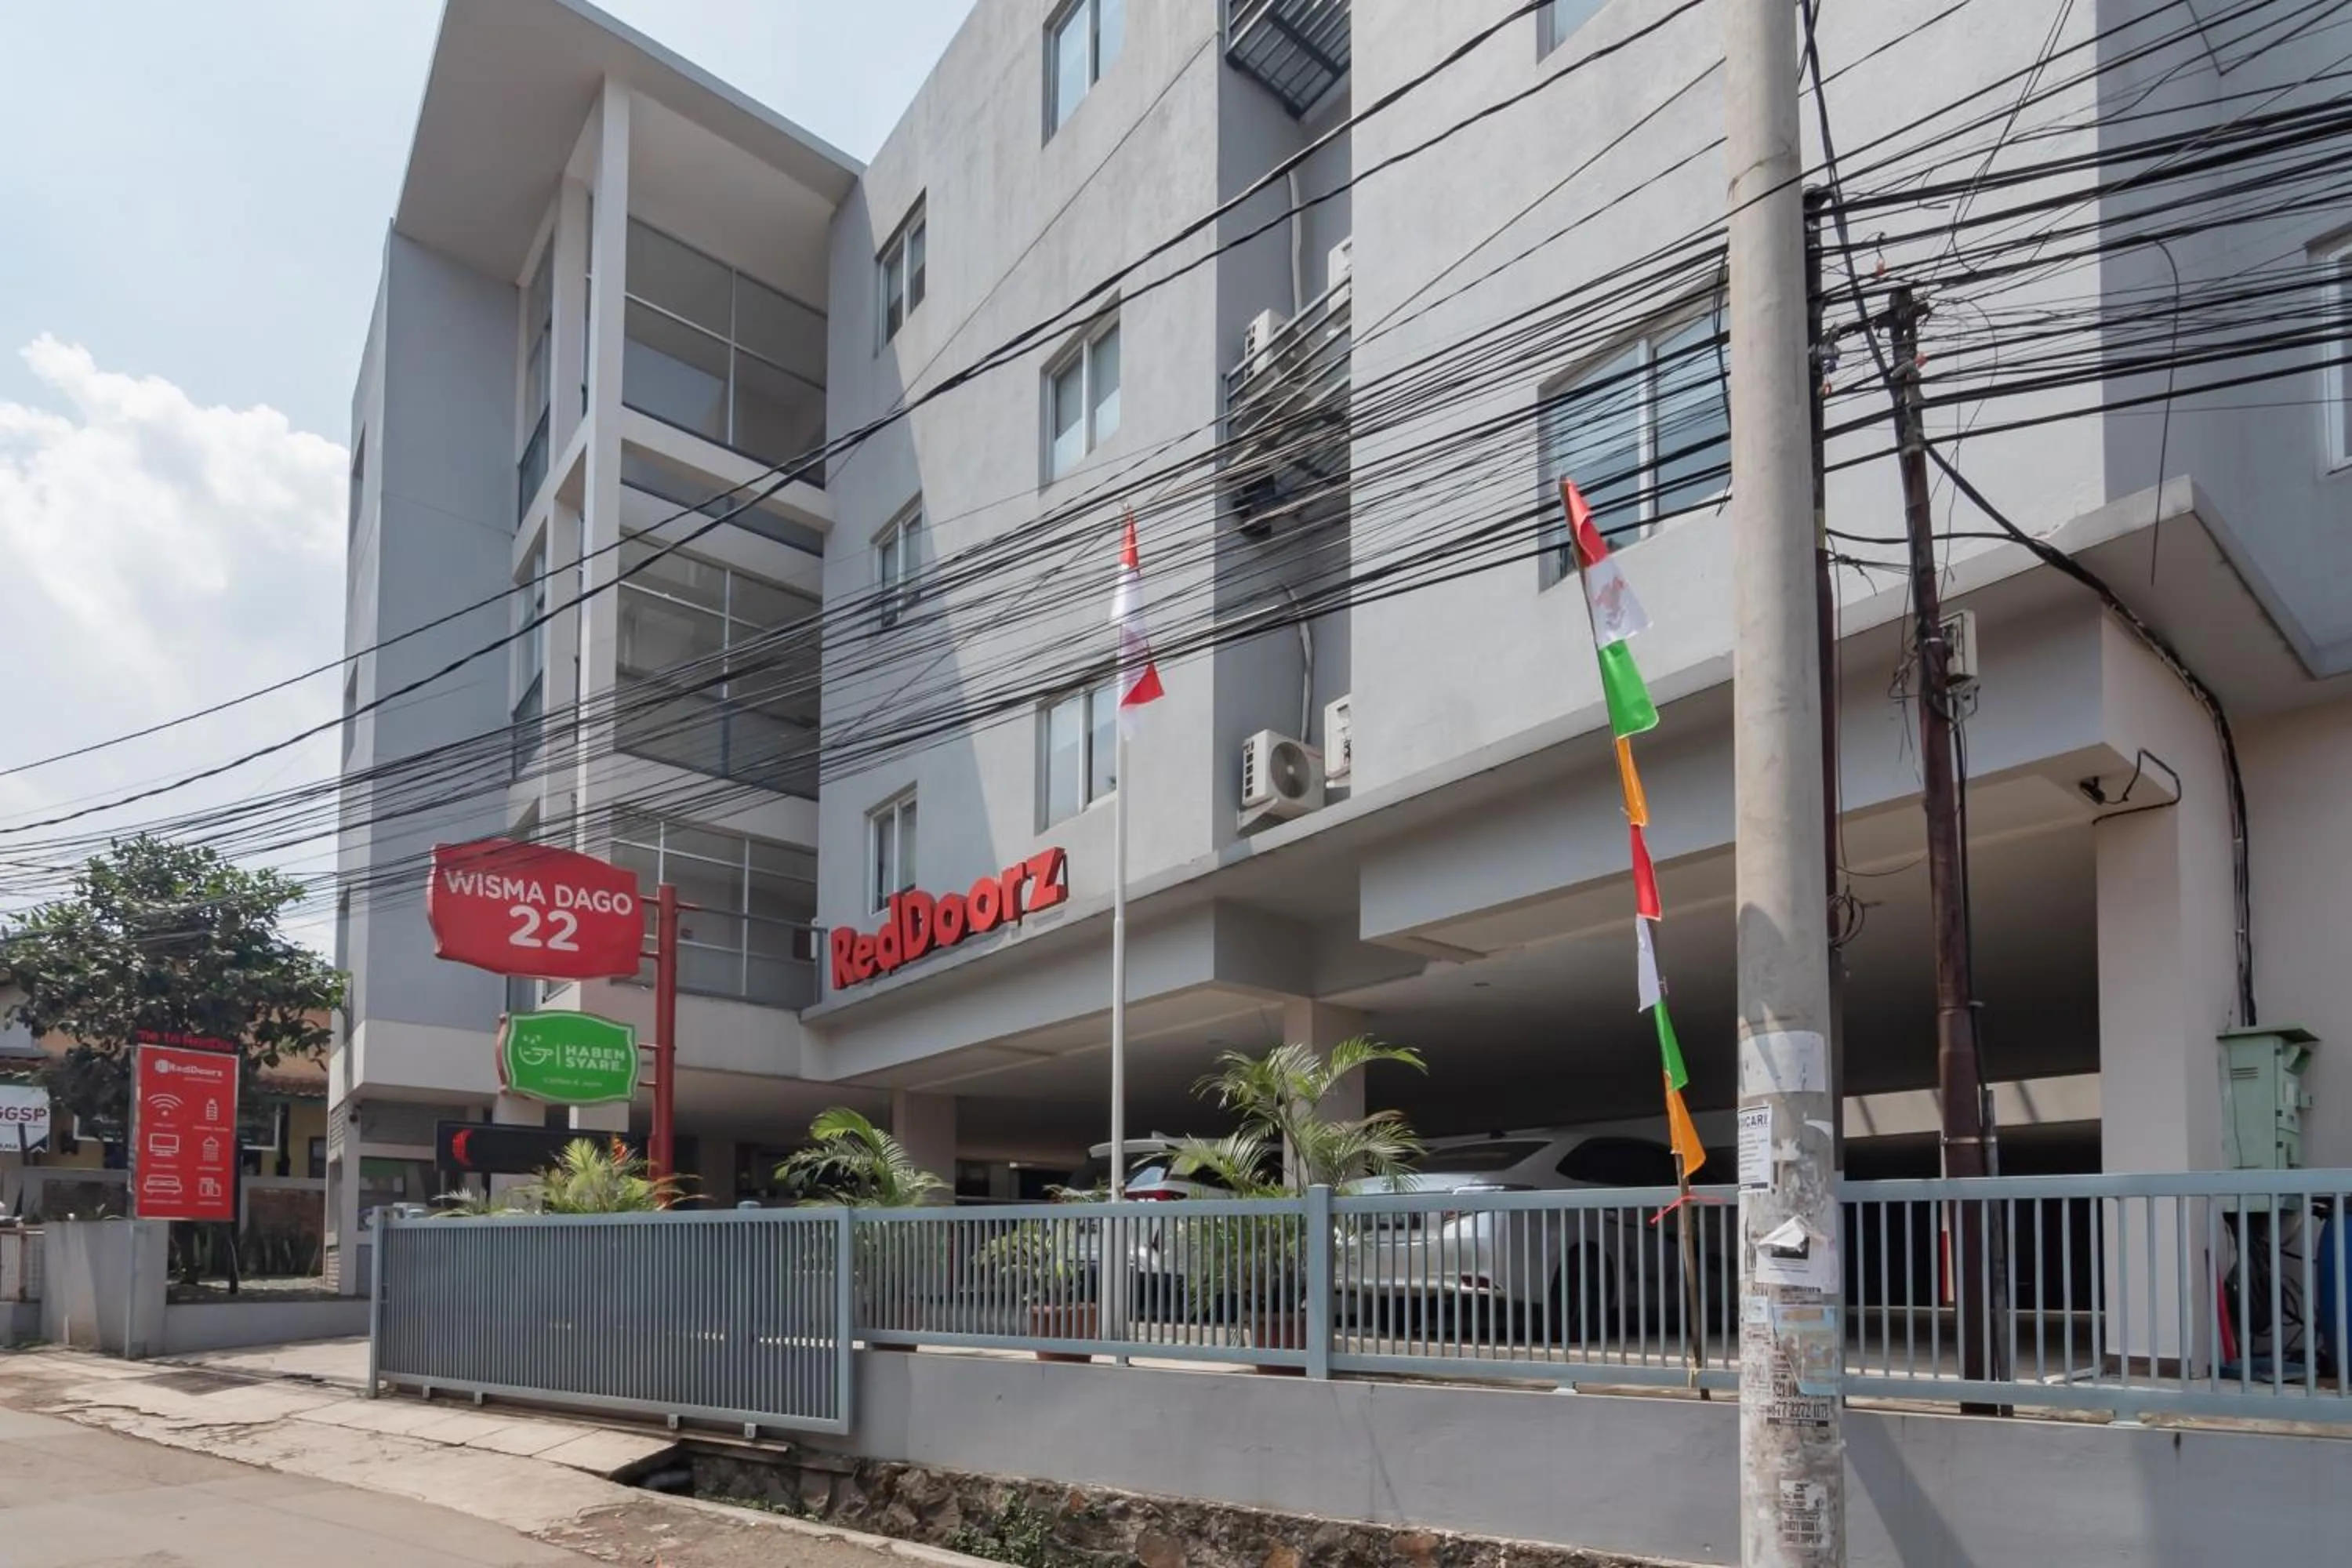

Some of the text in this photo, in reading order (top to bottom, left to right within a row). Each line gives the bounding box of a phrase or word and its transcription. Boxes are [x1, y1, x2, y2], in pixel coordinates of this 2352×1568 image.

[445, 868, 633, 916] WISMA DAGO
[509, 904, 579, 952] 22
[831, 846, 1069, 989] RedDoorz
[564, 1044, 626, 1061] HABEN
